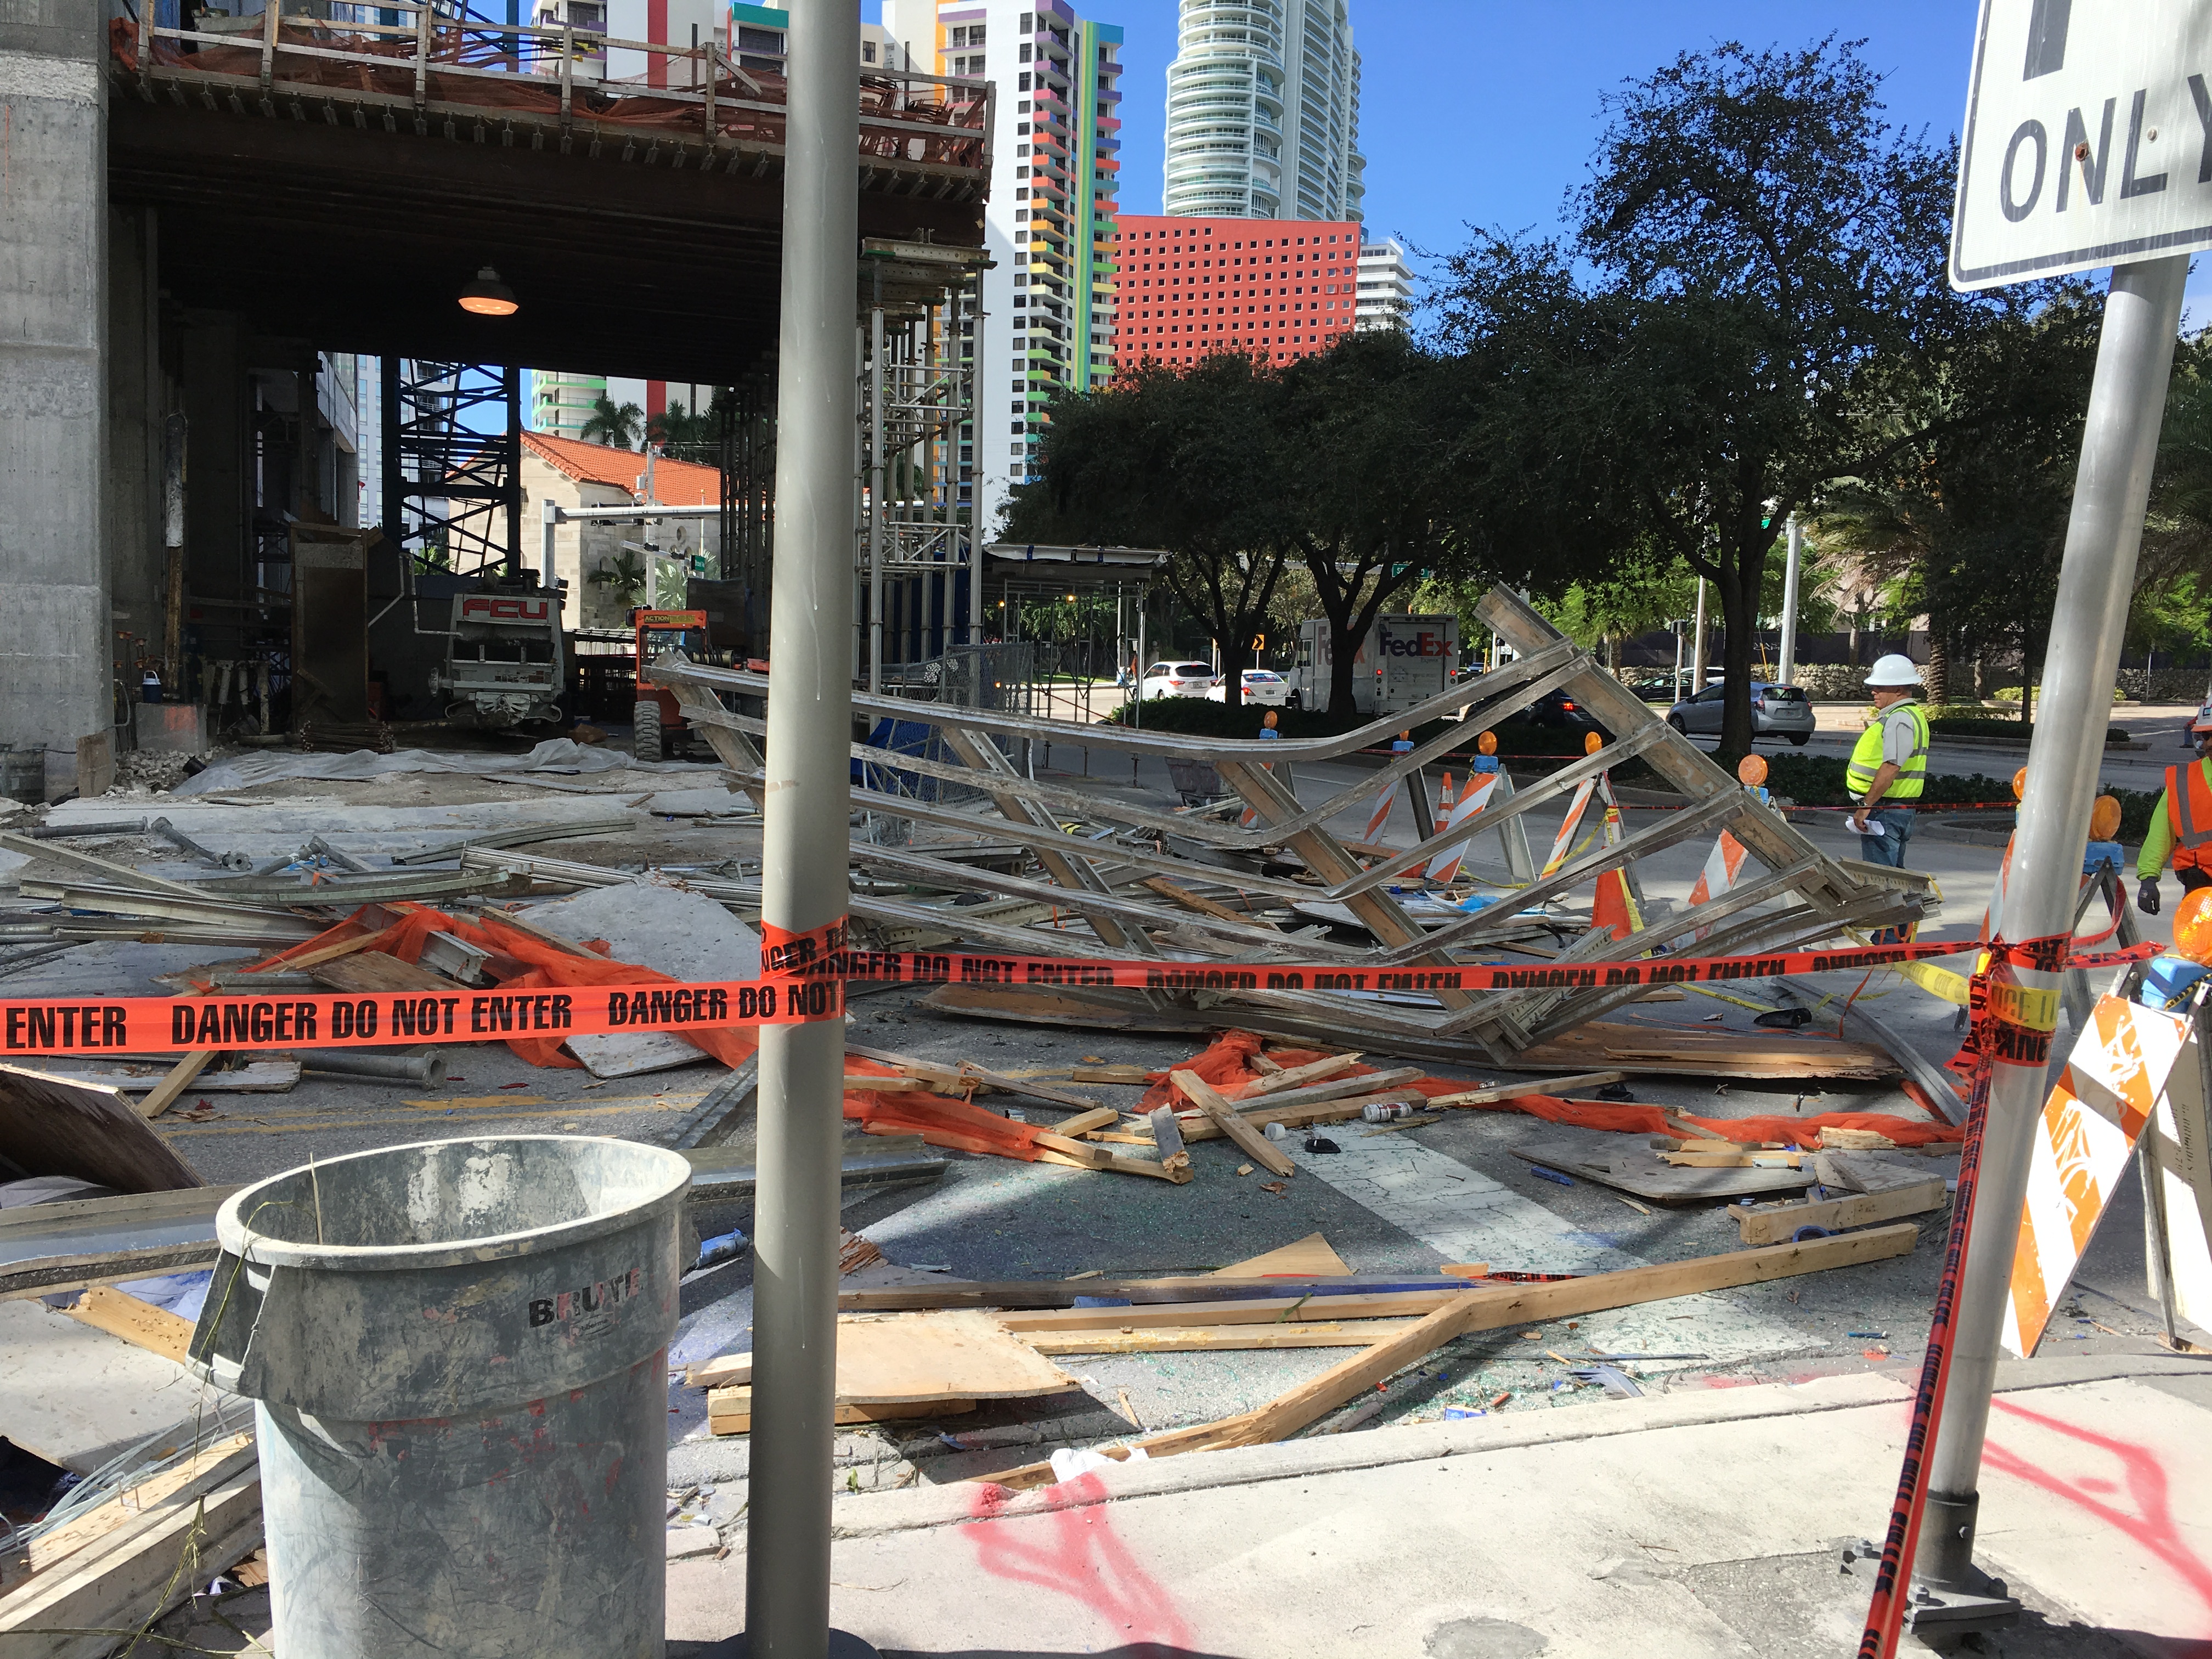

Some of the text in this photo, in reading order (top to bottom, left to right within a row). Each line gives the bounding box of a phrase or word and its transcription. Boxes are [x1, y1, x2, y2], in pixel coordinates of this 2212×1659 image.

[1317, 623, 1365, 665] Fex
[1379, 631, 1453, 657] FedEx
[912, 955, 950, 982] DO
[961, 958, 1017, 983] NOT
[1027, 963, 1114, 986] ENTER
[6, 981, 838, 1049] ENTER DANGER DO NOT ENTER DANGER DO NOT
[528, 1267, 640, 1328] BRUTE
